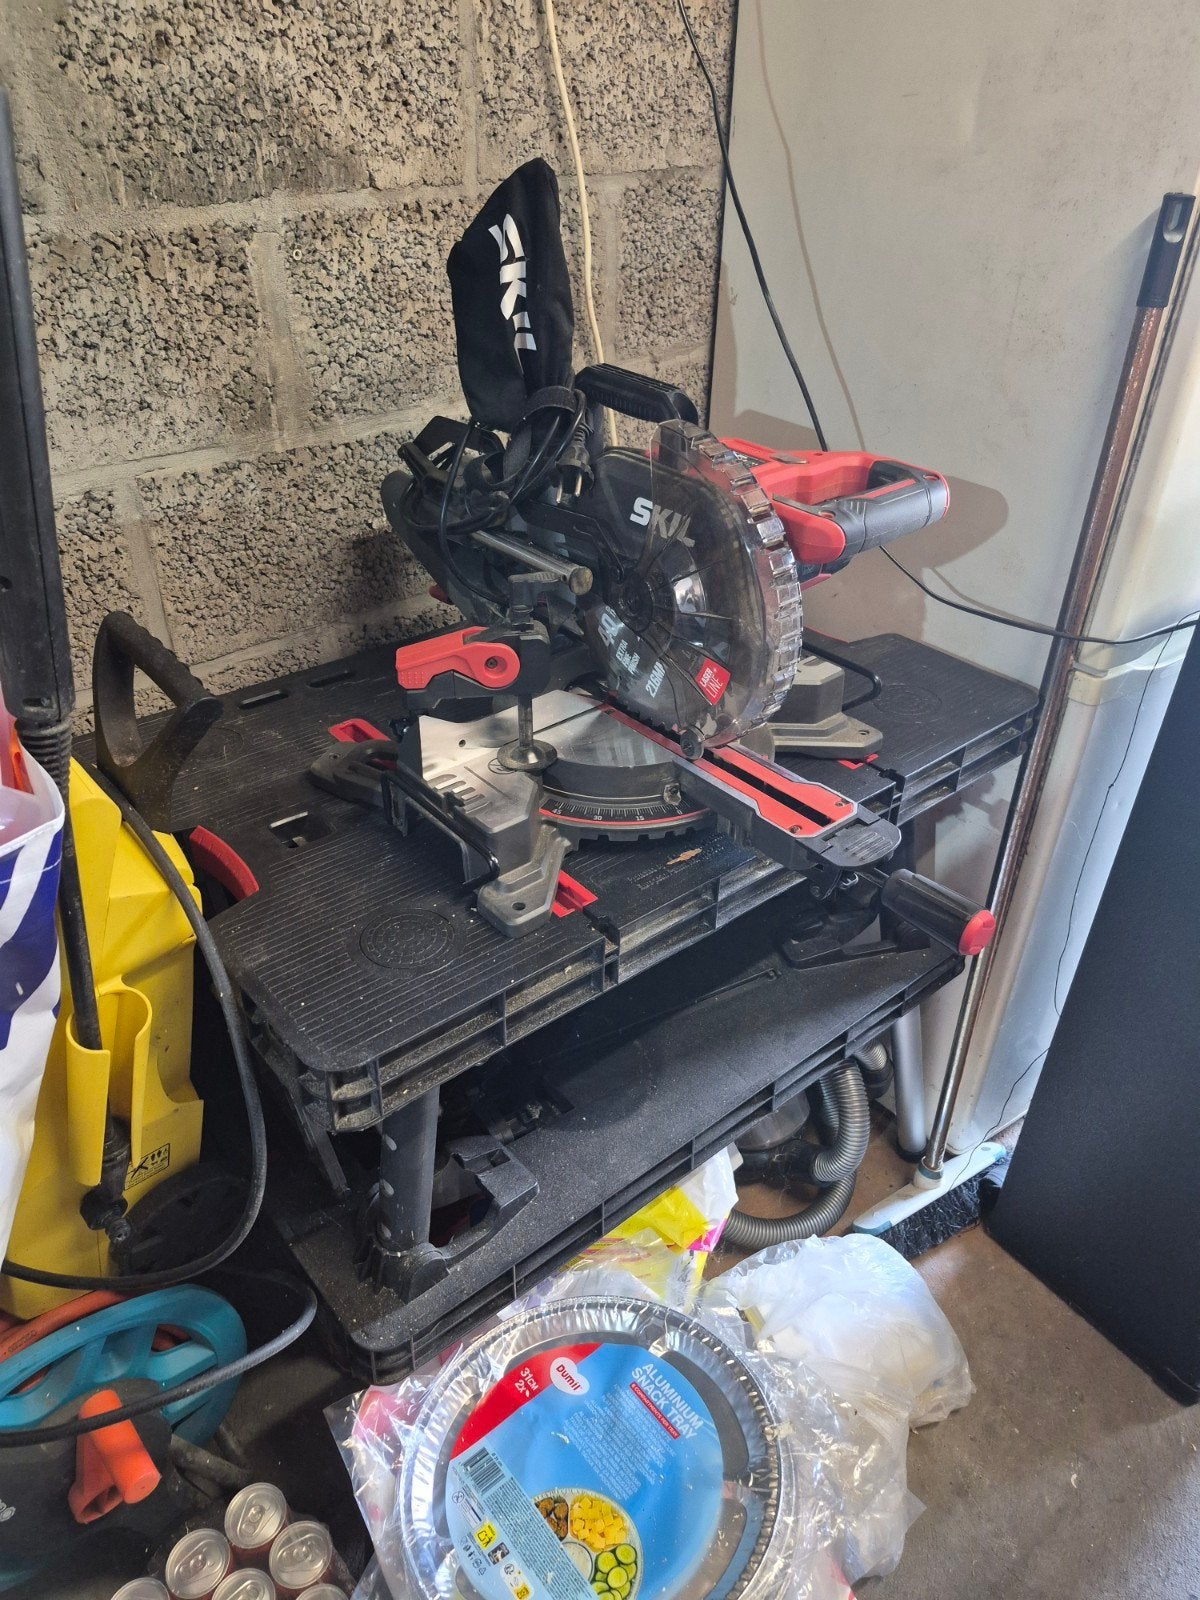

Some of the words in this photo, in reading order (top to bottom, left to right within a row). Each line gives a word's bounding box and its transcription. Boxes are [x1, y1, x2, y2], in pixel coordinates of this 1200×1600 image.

[629, 496, 696, 548] SKIL
[699, 667, 713, 688] LASER
[704, 674, 724, 698] LINE
[555, 1364, 581, 1391] Dumil
[631, 1367, 670, 1410] SNACK
[666, 1406, 698, 1439] TRAY
[642, 1363, 704, 1430] ALUMINIUM
[667, 1425, 678, 1437] TRAY
